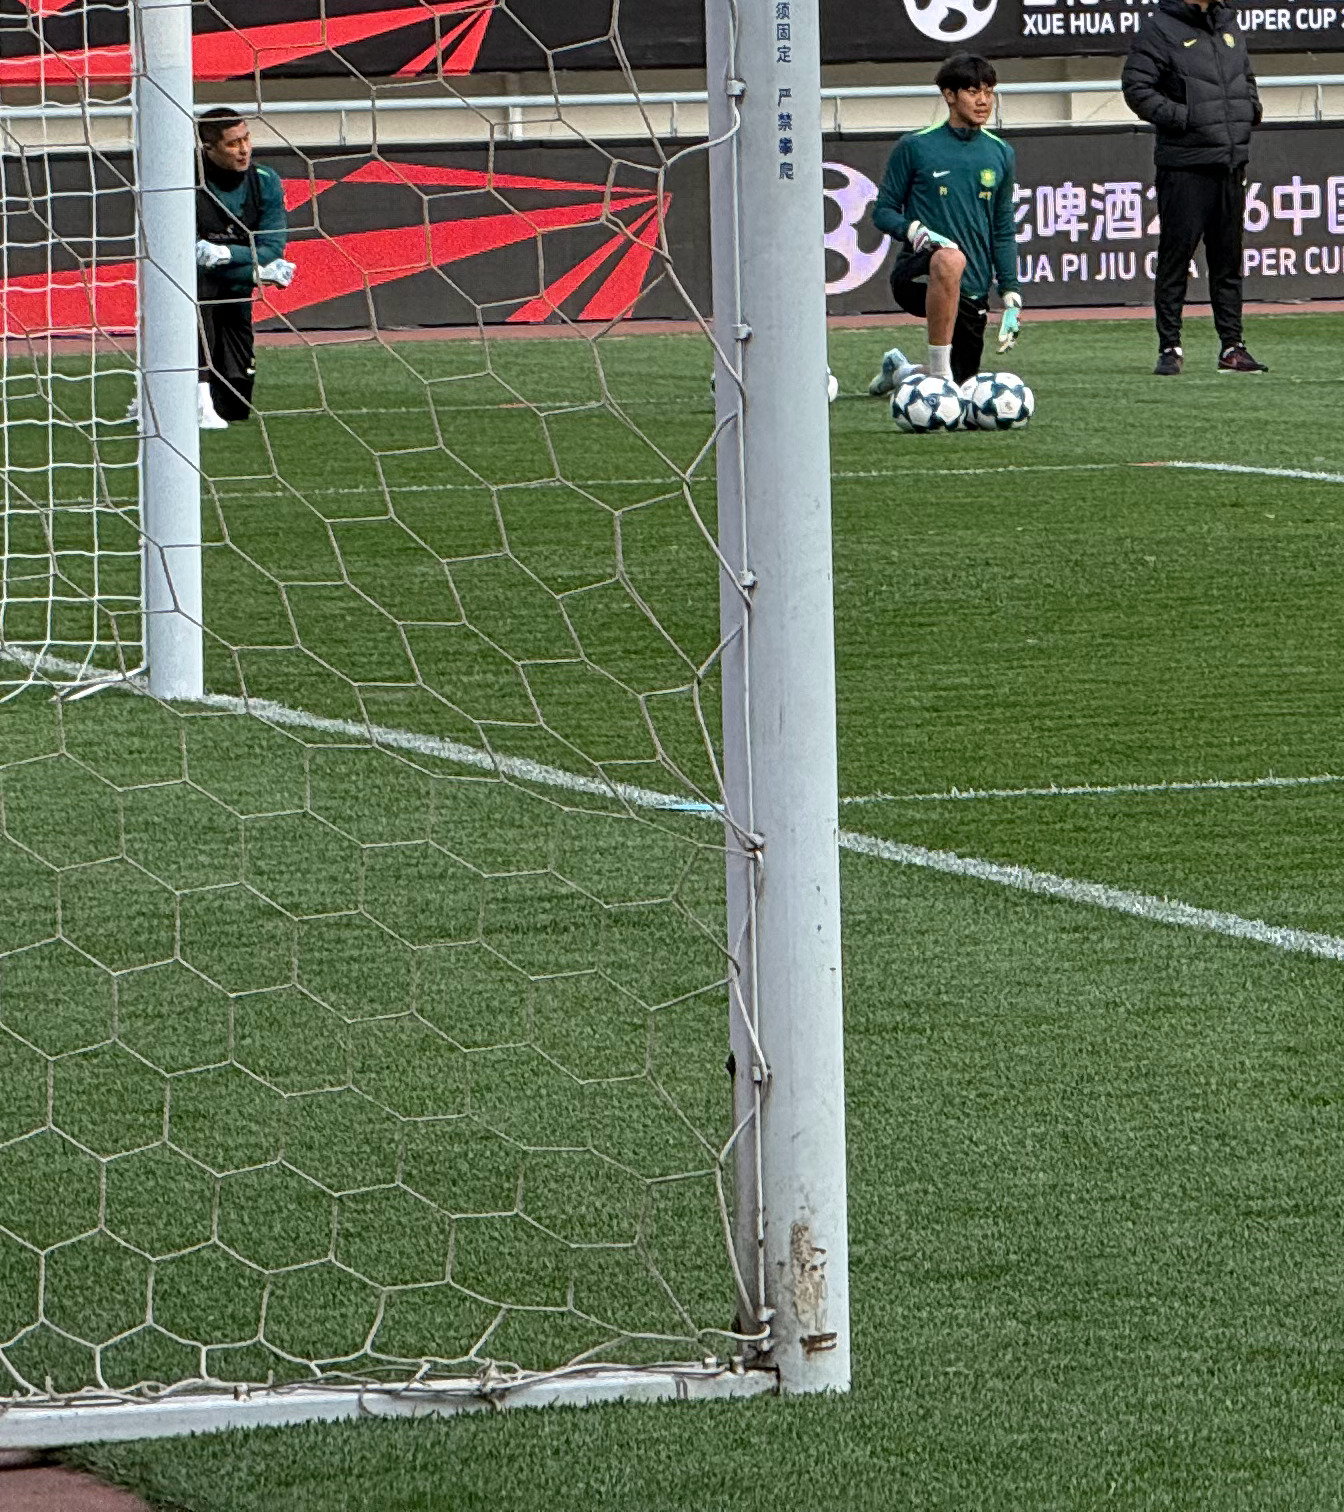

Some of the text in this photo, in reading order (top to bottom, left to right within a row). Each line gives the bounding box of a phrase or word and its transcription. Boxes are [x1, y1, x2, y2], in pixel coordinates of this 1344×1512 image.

[1022, 12, 1065, 35] XUE
[1069, 12, 1116, 35] HUA
[1119, 11, 1140, 34] PI
[1236, 8, 1291, 31] UPER
[1295, 7, 1337, 30] CUP
[1016, 254, 1056, 283] UA
[1062, 252, 1089, 282] PI
[1094, 251, 1137, 281] JIU
[1243, 247, 1298, 277] PER
